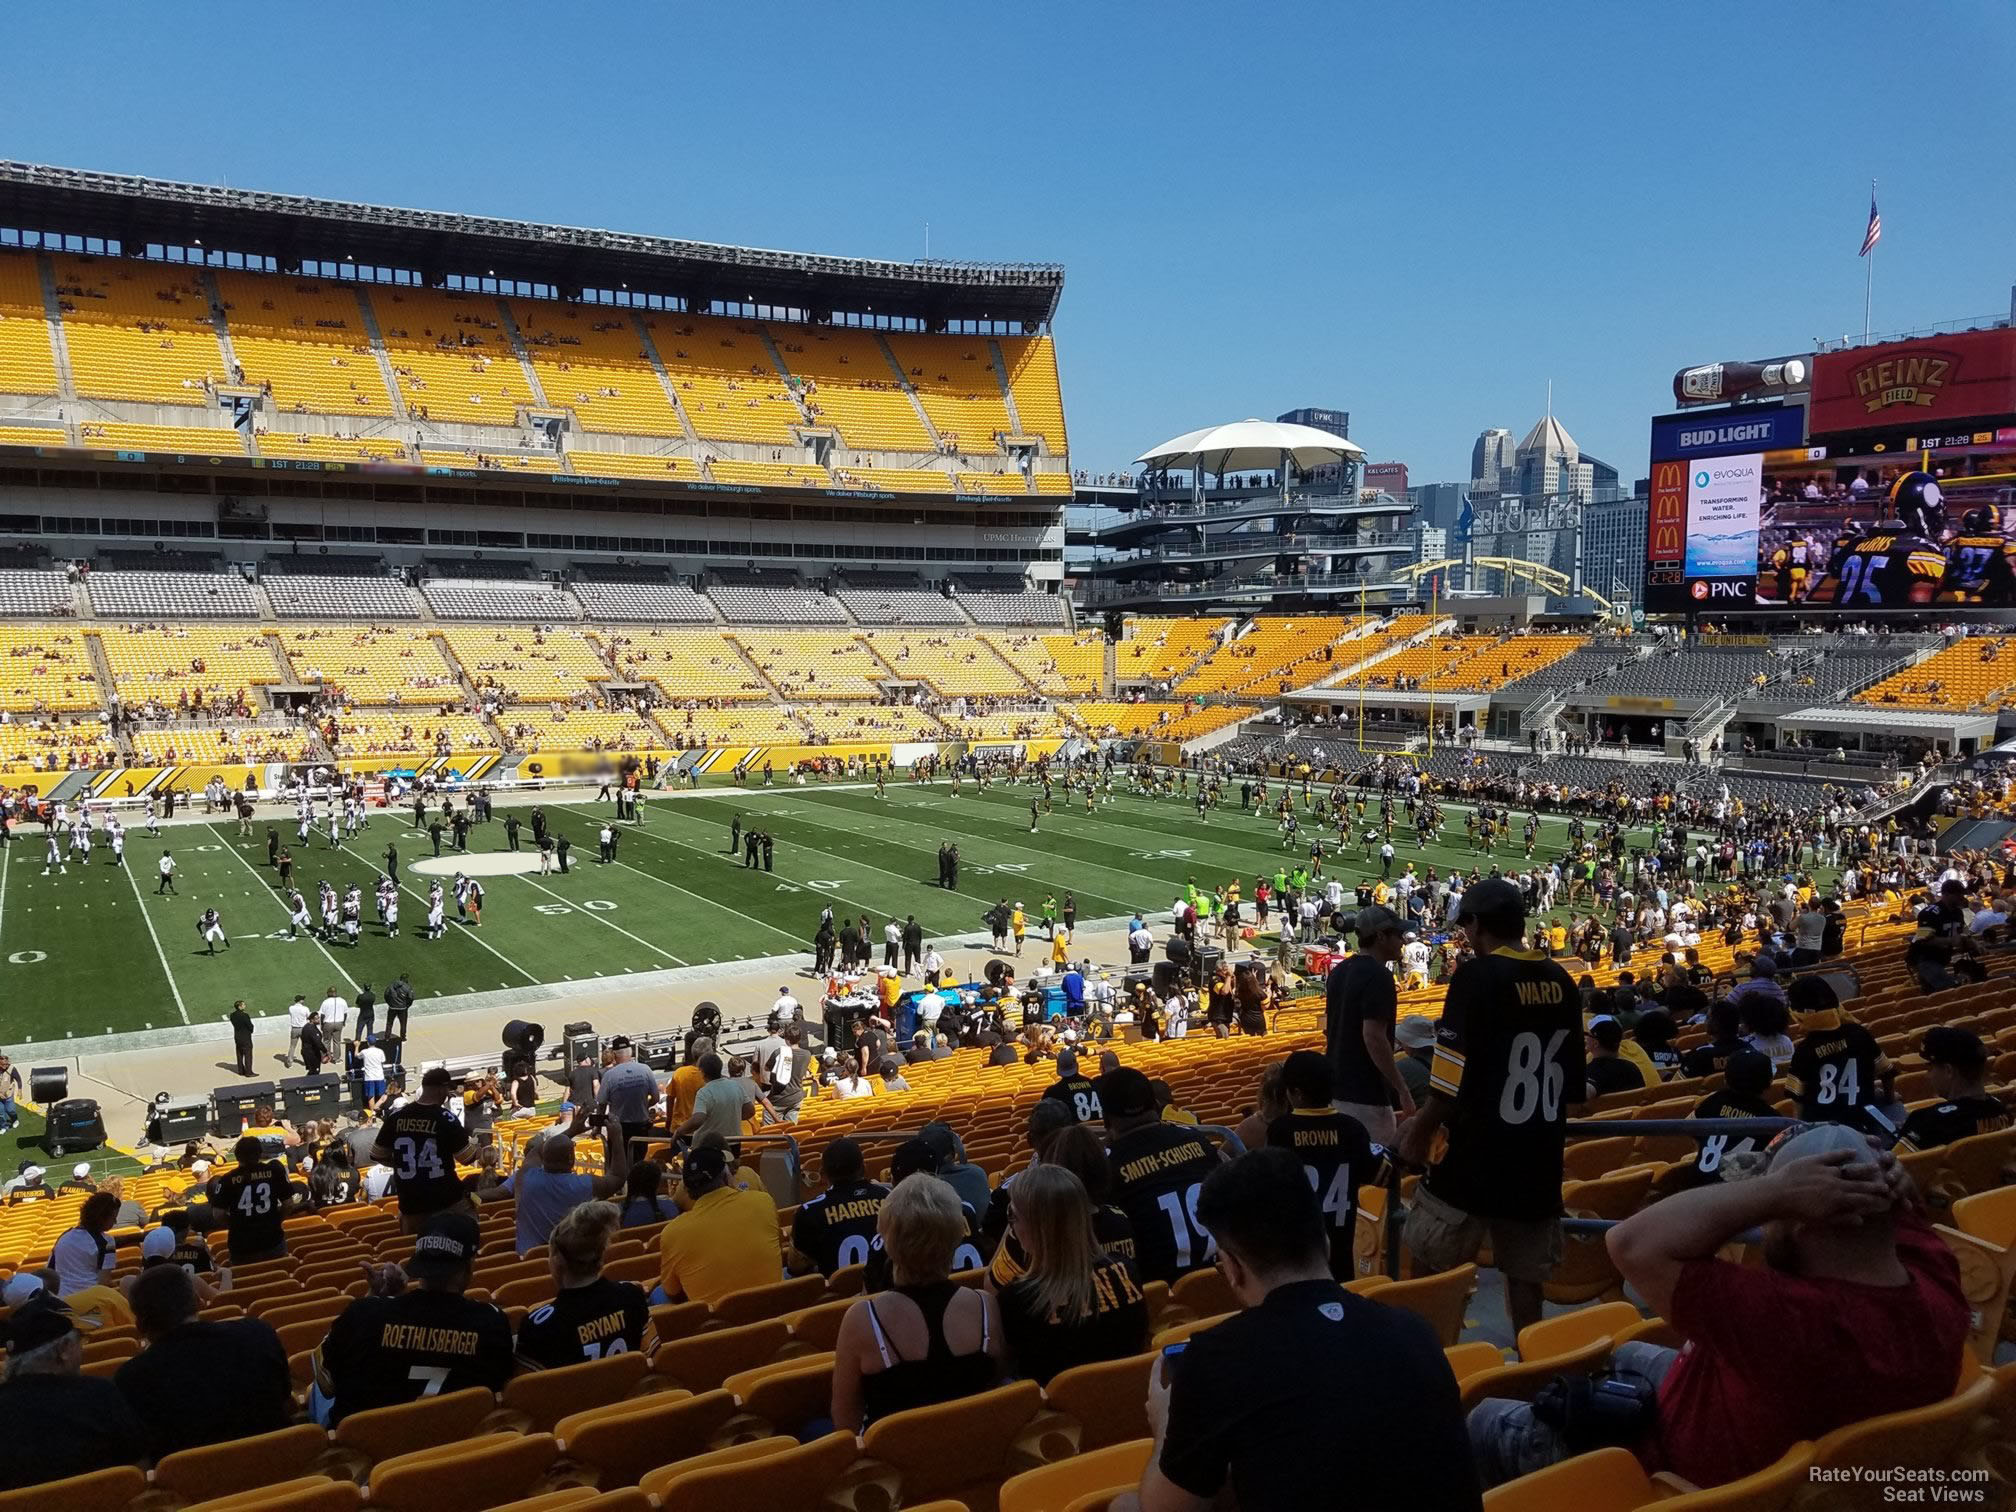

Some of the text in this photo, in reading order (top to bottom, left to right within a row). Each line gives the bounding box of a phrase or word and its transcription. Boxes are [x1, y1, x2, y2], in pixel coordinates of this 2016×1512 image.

[1856, 358, 1949, 396] HEINZ
[1886, 388, 1913, 402] FIELD
[1314, 413, 1333, 421] UPMC
[1680, 423, 1770, 447] BUD LIGHT
[1922, 435, 1969, 449] 1ST 21:28
[1813, 450, 1820, 458] 0
[271, 459, 320, 470] 1ST 21:28
[717, 485, 743, 493] Pittsburgh
[853, 491, 878, 499] Pittsburgh
[1700, 496, 1748, 505] TRANSFORMING
[1477, 505, 1579, 534] PEOPLES
[983, 534, 1009, 542] UPMC
[1711, 582, 1747, 597] PNC
[1391, 607, 1421, 617] FORD
[1616, 605, 1627, 615] D
[1702, 635, 1718, 645] LIVE
[1721, 635, 1748, 645] UNITED
[1415, 951, 1425, 963] 84
[1515, 981, 1563, 1005] WARD
[1027, 1002, 1040, 1014] 90
[1815, 1038, 1848, 1058] BROWN
[1499, 1029, 1571, 1125] 86
[1817, 1058, 1860, 1105] 84
[802, 1086, 812, 1097] 7
[1069, 1081, 1091, 1091] BROWN
[456, 1108, 463, 1117] 7
[1073, 1091, 1103, 1121] 84
[396, 1118, 437, 1134] RUSSELL
[1294, 1130, 1338, 1146] BROWN
[394, 1137, 445, 1180] 34
[1120, 1141, 1206, 1184] SMITH-SCHUSTER
[238, 1182, 271, 1216] 43
[578, 1310, 626, 1344] BRYANT
[381, 1323, 479, 1354] ROETHLISBERGER
[408, 1365, 451, 1402] 7
